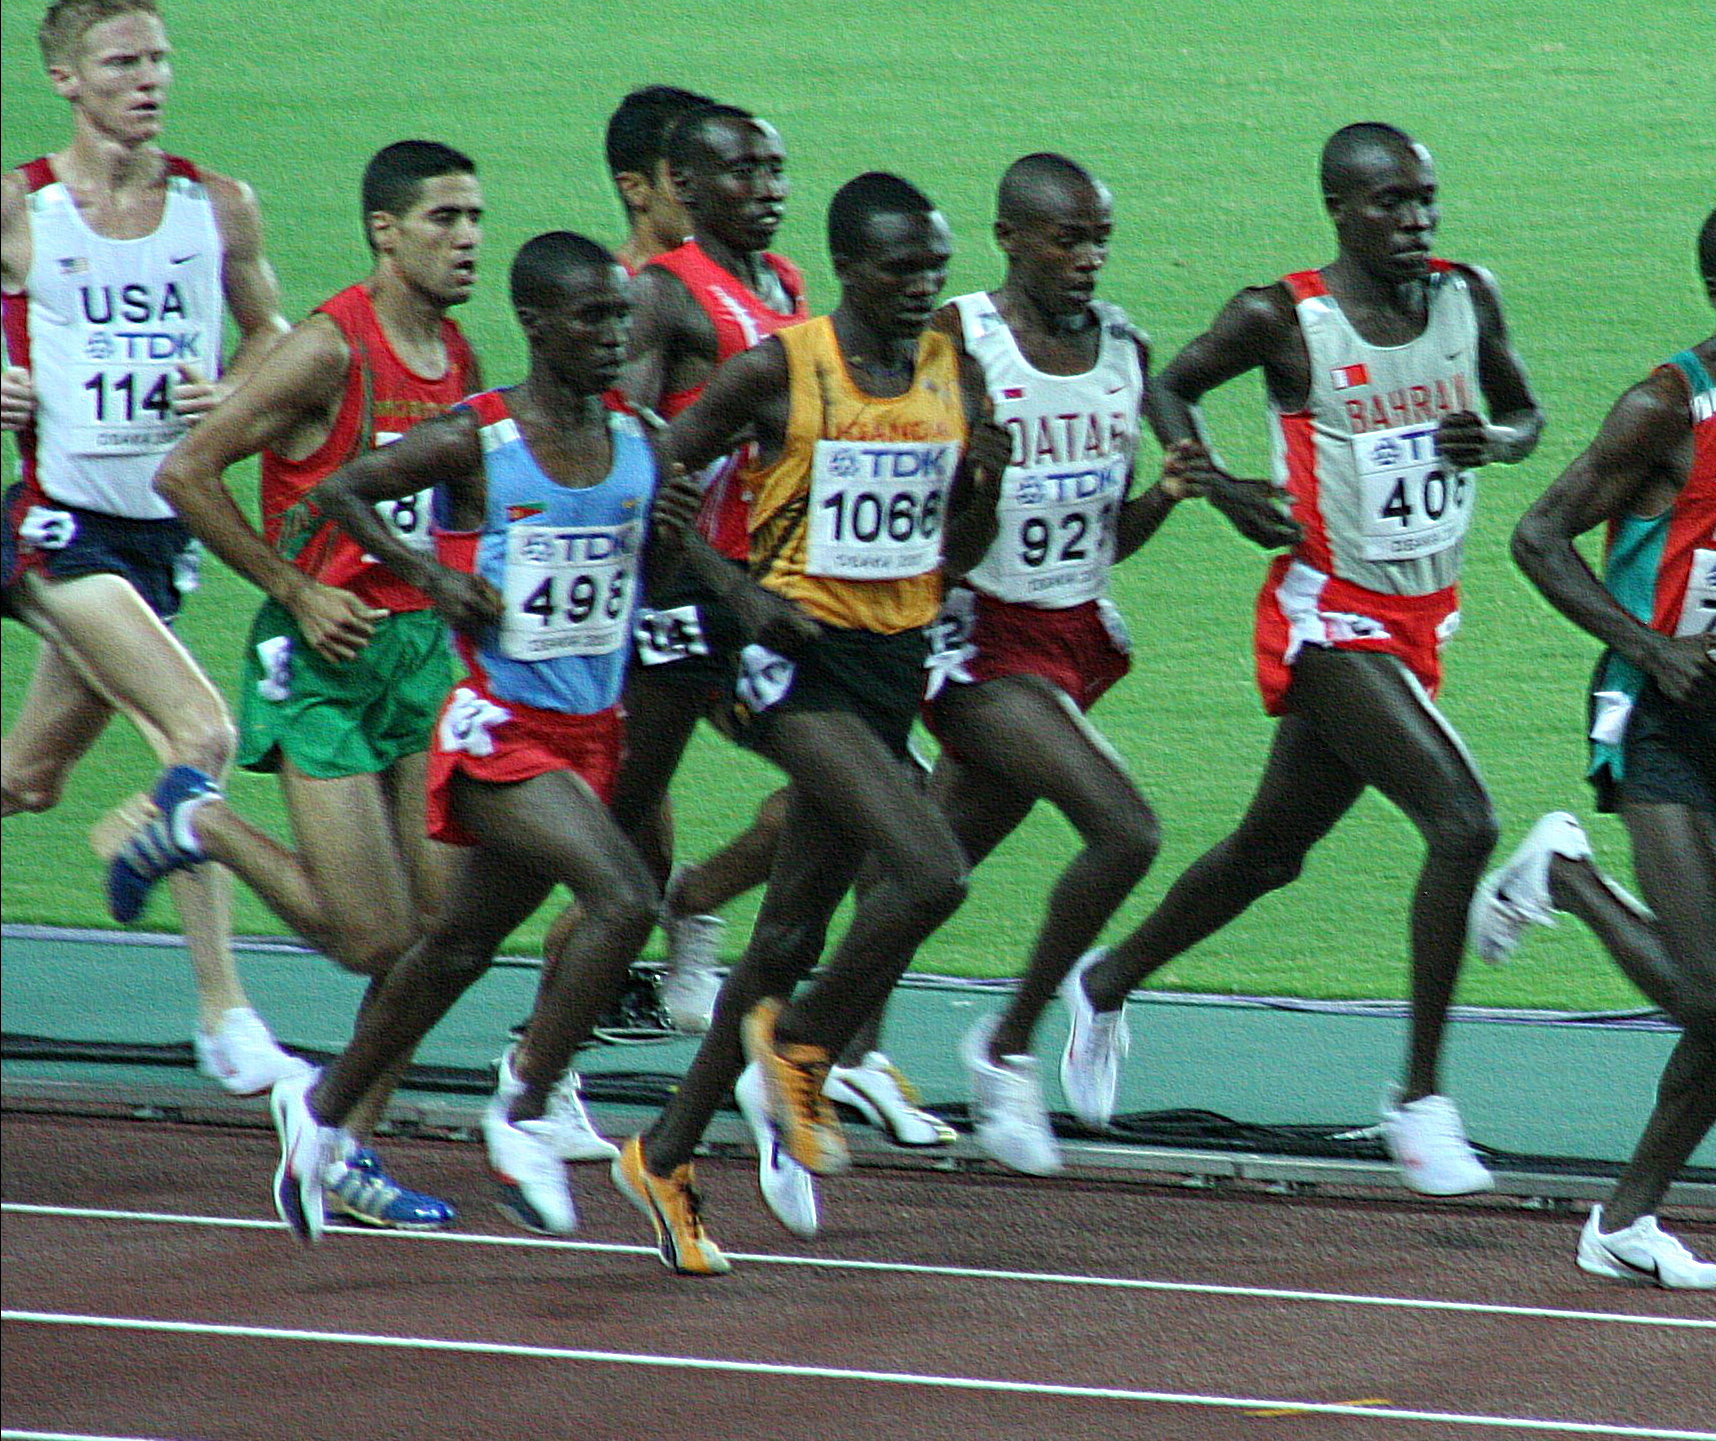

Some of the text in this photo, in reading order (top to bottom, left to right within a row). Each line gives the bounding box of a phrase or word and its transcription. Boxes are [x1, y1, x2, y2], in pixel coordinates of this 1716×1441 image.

[80, 283, 187, 324] USA
[114, 332, 199, 360] TDK
[85, 371, 174, 422] 114
[861, 450, 948, 478] TDK
[821, 489, 942, 543] 1066
[522, 569, 625, 627] 498
